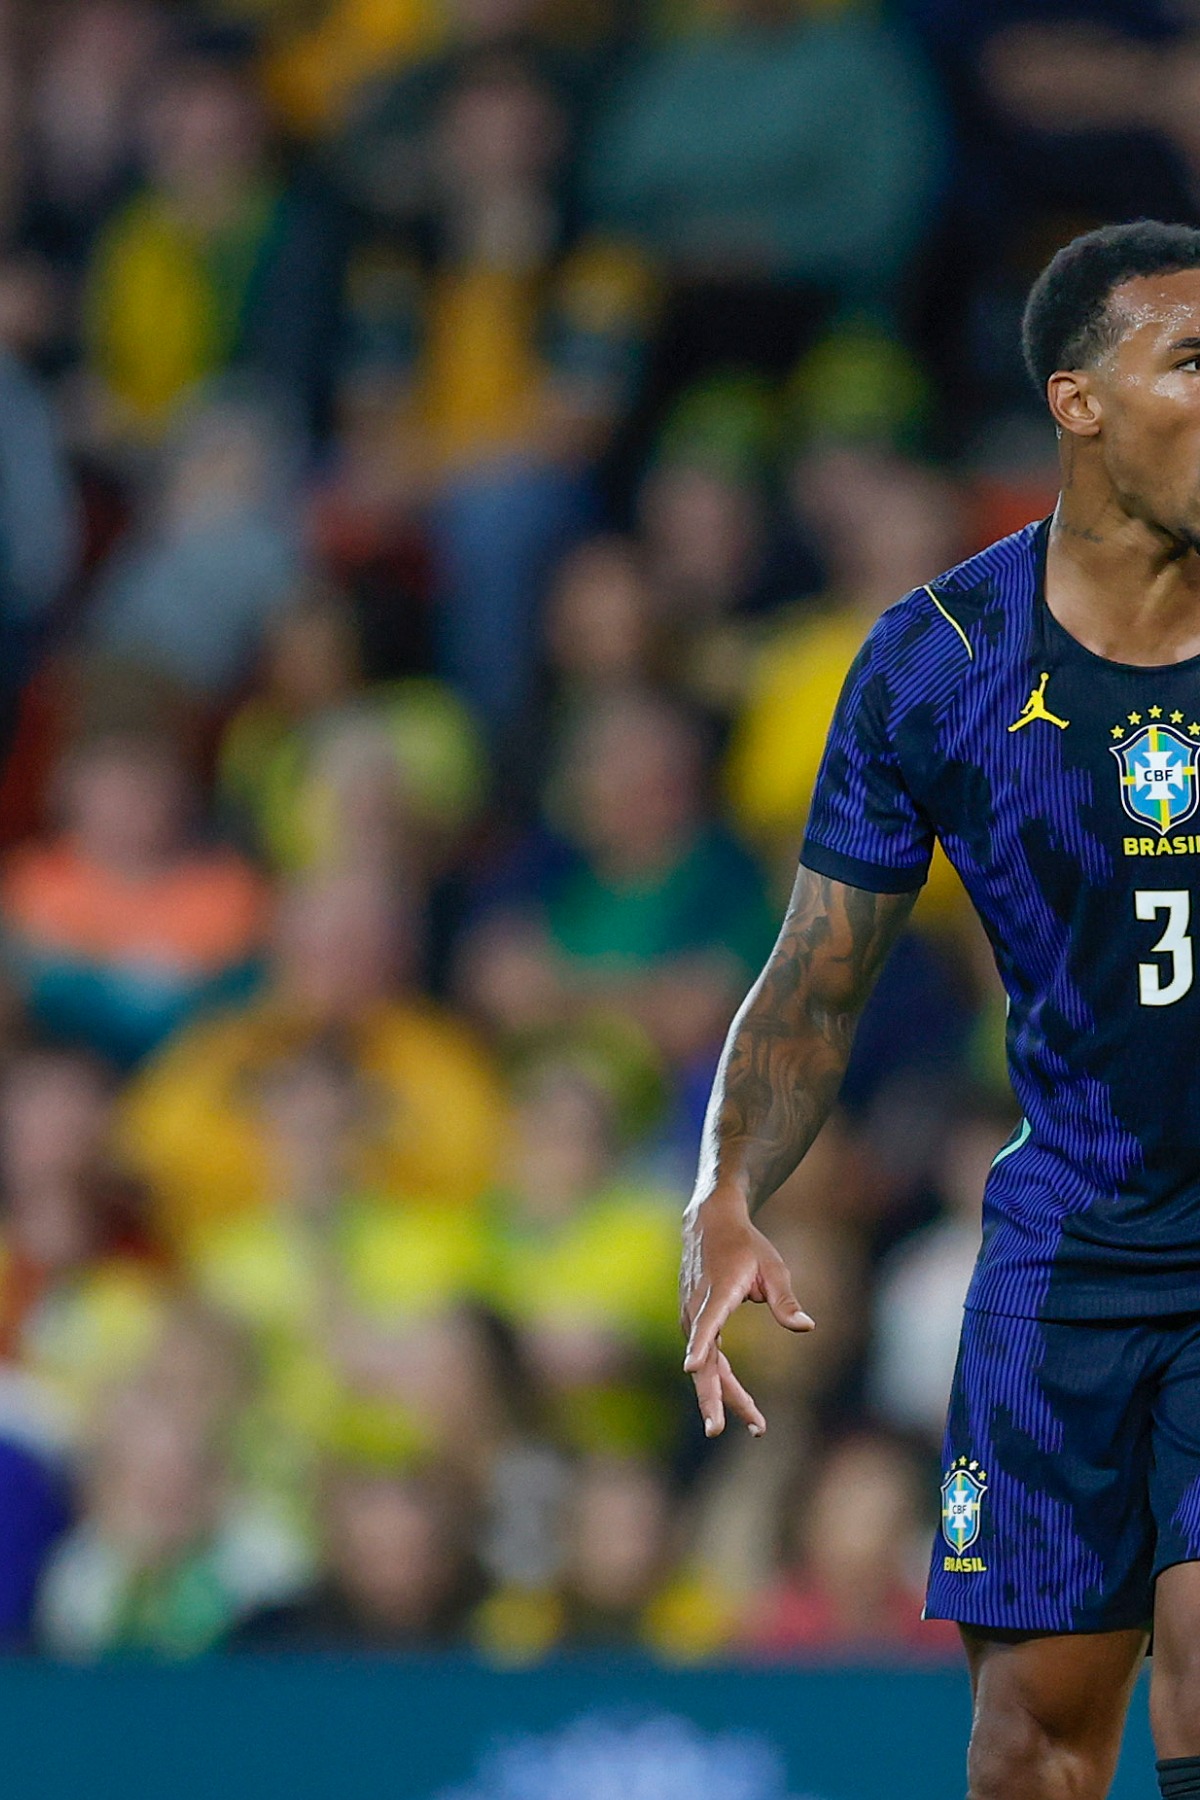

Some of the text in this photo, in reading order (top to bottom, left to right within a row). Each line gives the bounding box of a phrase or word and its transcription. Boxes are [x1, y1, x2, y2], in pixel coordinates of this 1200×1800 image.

[1144, 770, 1173, 782] CBF
[1135, 890, 1194, 1006] 3
[952, 1505, 967, 1515] CBF
